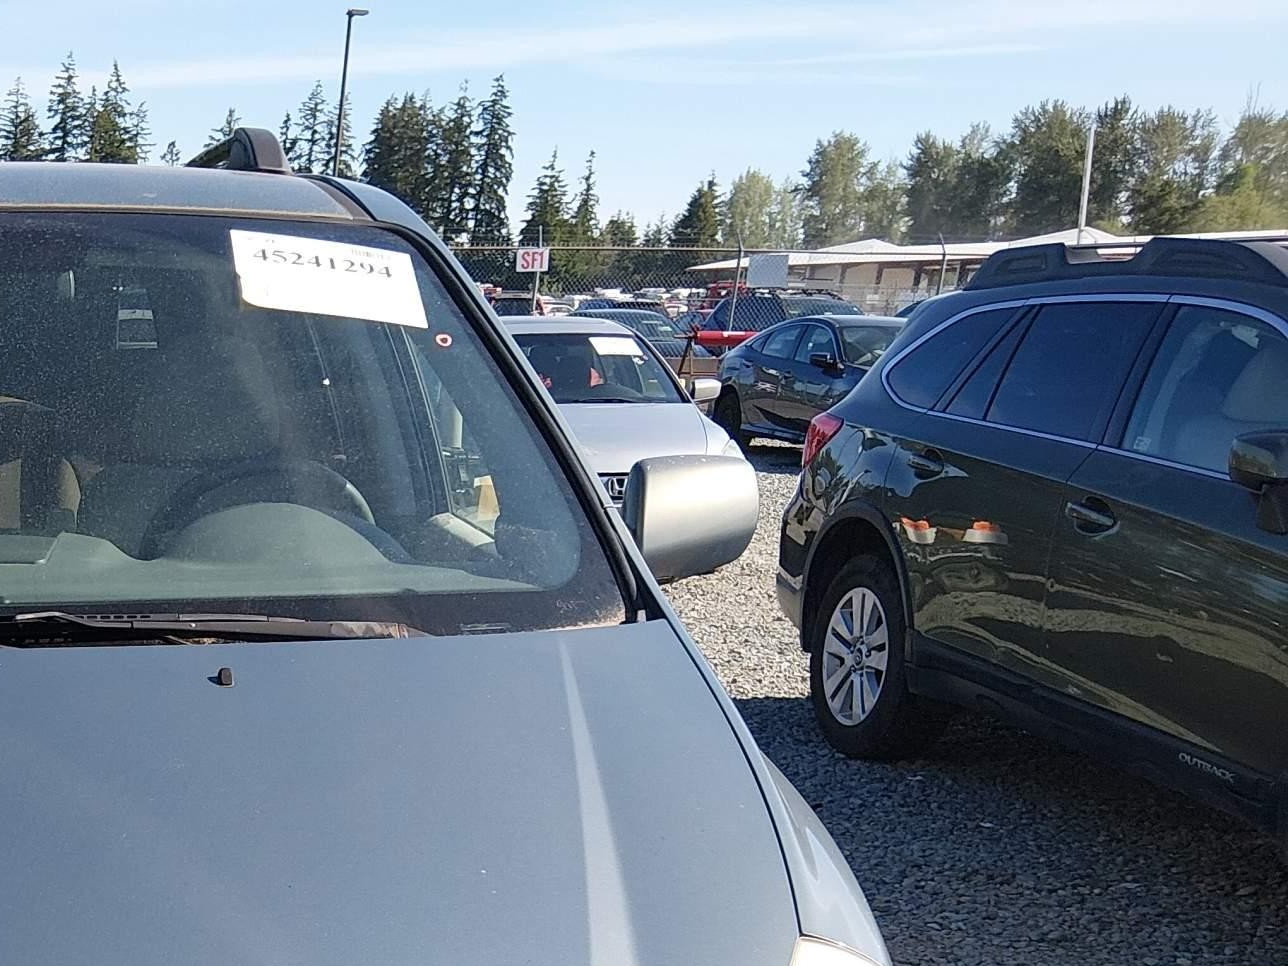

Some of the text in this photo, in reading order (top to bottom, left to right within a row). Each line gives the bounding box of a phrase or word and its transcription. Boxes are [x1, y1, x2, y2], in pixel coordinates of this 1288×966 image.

[253, 249, 392, 278] 45241294
[521, 251, 544, 269] SF1
[1178, 752, 1236, 783] OUTBACK
